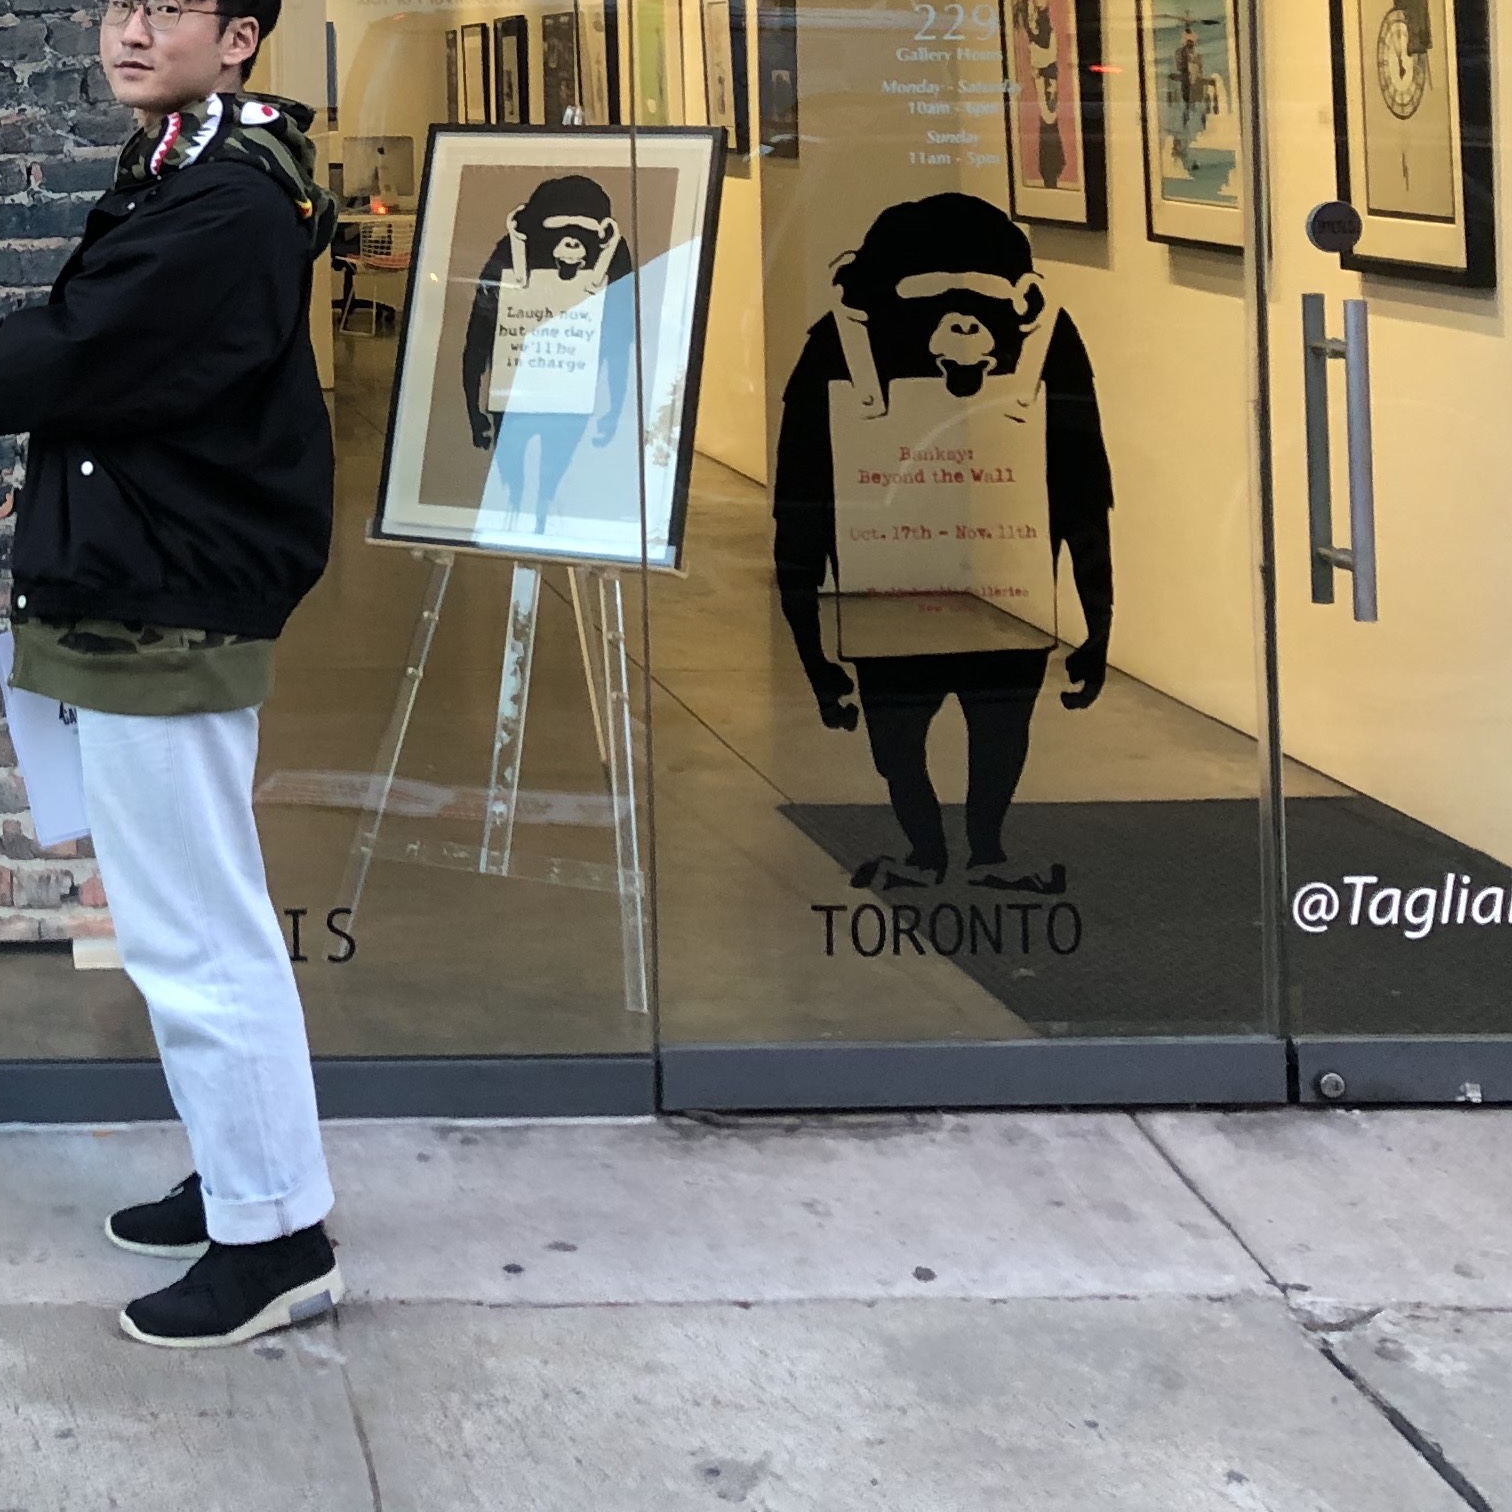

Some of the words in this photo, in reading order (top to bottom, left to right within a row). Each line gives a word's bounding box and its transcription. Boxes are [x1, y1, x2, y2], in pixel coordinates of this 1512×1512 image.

[913, 2, 999, 42] 229
[895, 46, 950, 65] Gallery
[881, 78, 940, 97] Monday
[506, 306, 554, 322] Laugh
[499, 324, 525, 337] but
[506, 356, 521, 368] in
[528, 357, 586, 373] charge
[858, 469, 926, 486] Beyond
[933, 469, 965, 484] the
[970, 468, 1017, 484] Wall
[955, 525, 993, 540] Nov.
[1291, 872, 1512, 939] @Taglia
[811, 901, 1083, 958] TORONTO
